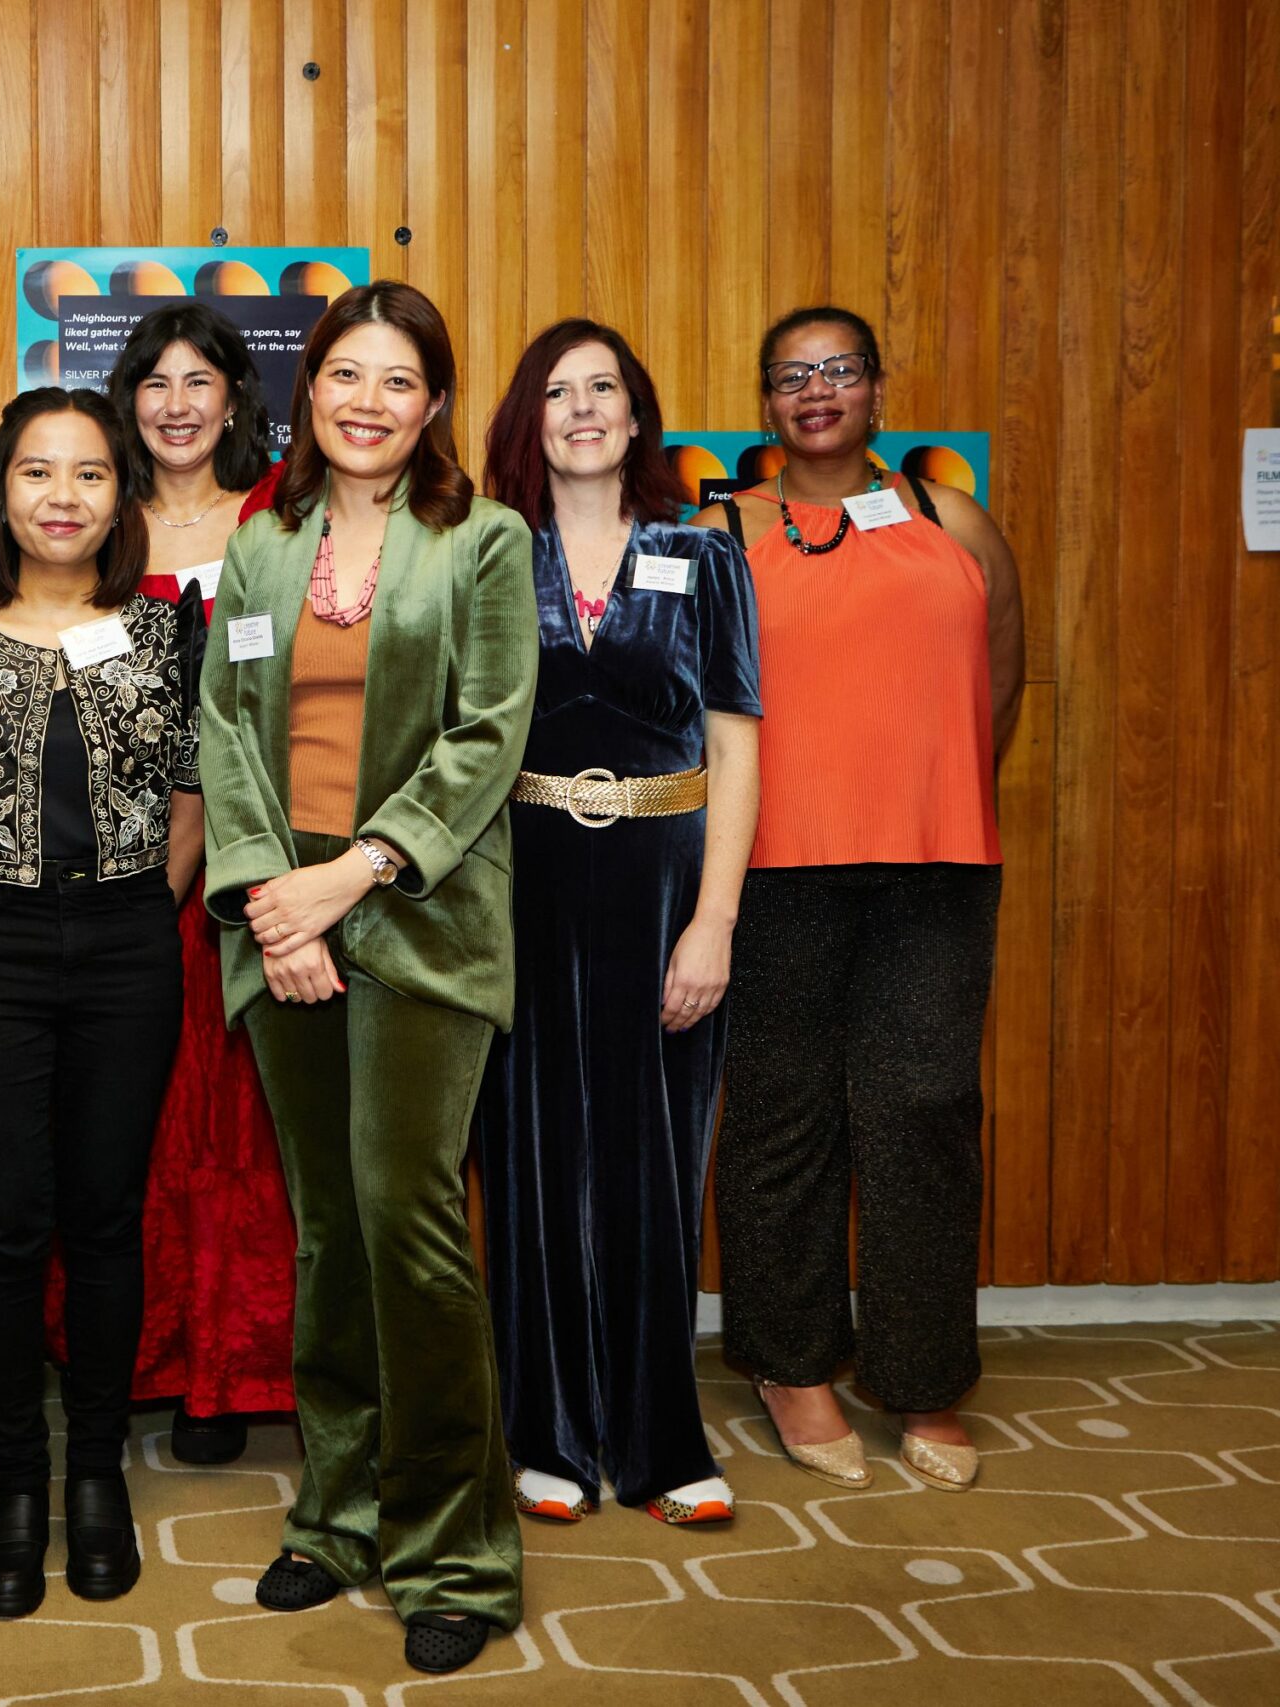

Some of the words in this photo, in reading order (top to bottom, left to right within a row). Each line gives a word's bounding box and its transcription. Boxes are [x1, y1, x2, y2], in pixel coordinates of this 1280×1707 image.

[129, 316, 143, 324] yo
[65, 328, 89, 337] liked
[90, 328, 122, 338] gather
[253, 329, 282, 338] opera,
[284, 329, 301, 338] say
[65, 342, 91, 352] Well,
[94, 342, 118, 351] what
[258, 342, 266, 350] in
[269, 342, 284, 350] the
[65, 370, 100, 379] SILVER
